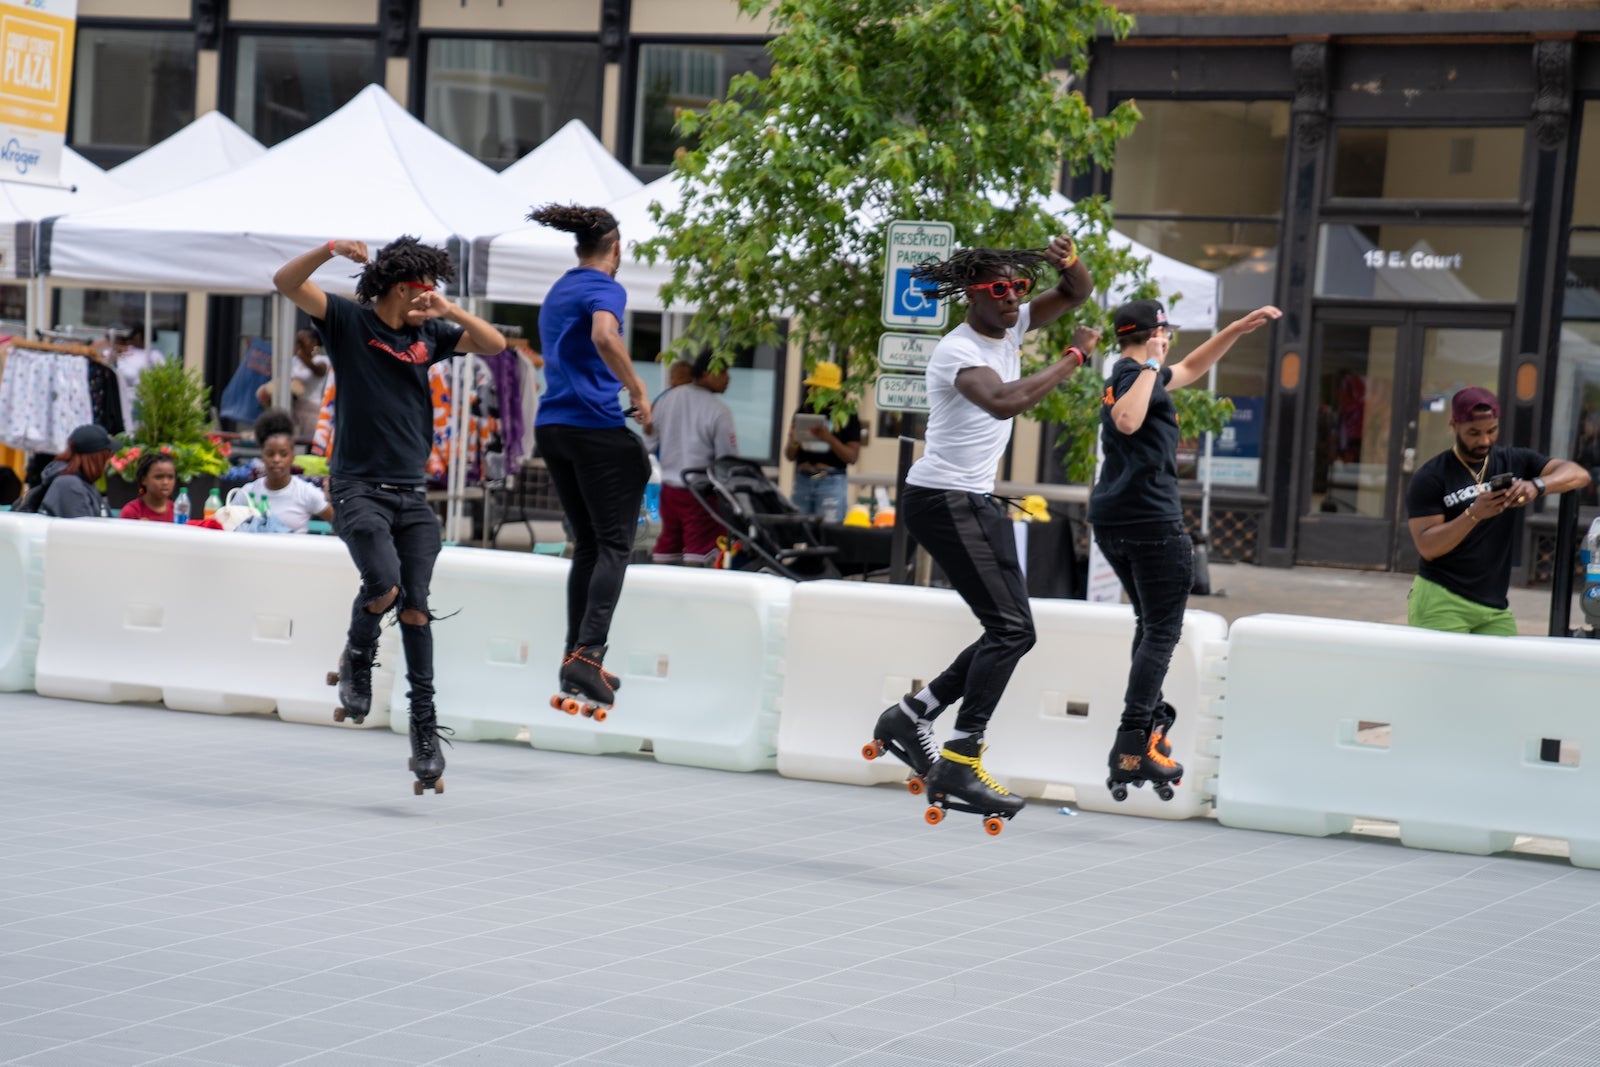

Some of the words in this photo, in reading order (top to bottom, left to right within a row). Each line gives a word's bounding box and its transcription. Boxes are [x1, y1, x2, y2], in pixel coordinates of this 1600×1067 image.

[4, 48, 51, 92] PLAZA
[1, 138, 40, 175] Kroger
[893, 232, 948, 247] RESERVED
[1363, 250, 1384, 268] 15
[1388, 251, 1406, 268] E.
[1410, 251, 1461, 269] Court
[901, 342, 923, 353] VAN
[885, 381, 907, 392] $250
[912, 382, 927, 393] FIN
[887, 394, 928, 405] MINIMUM
